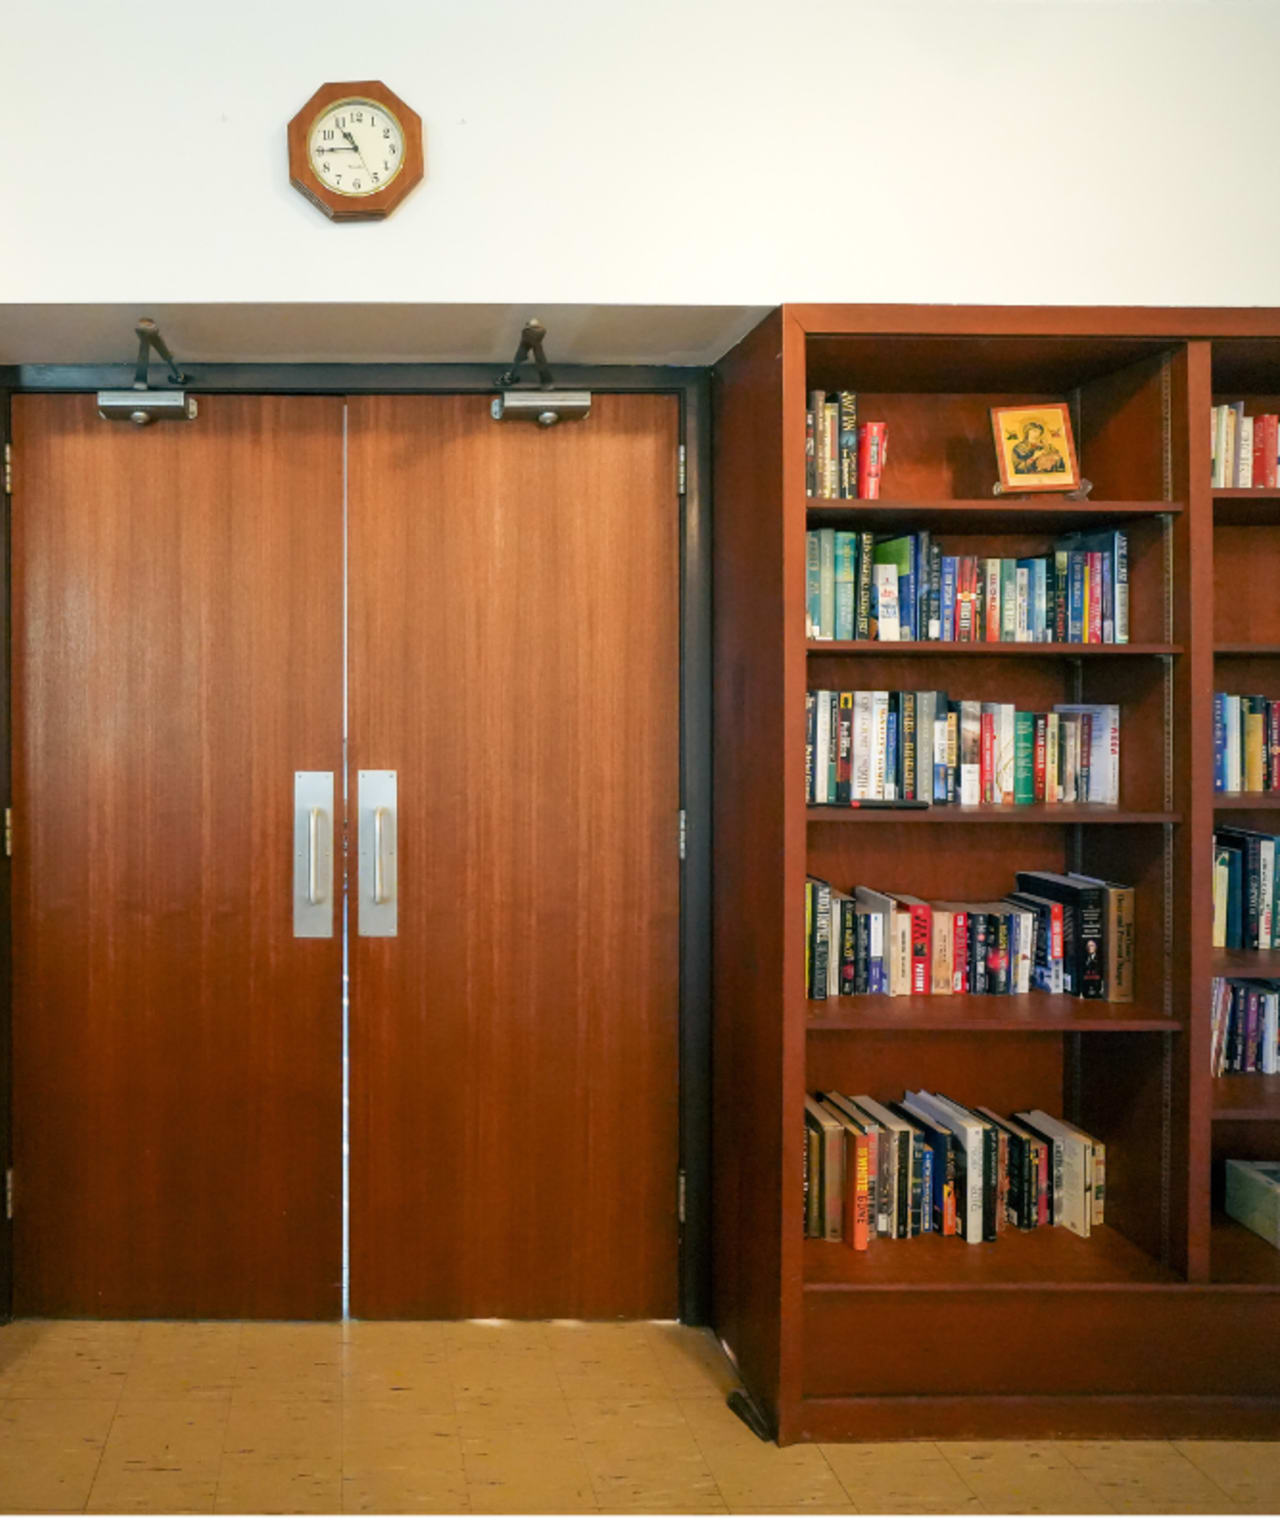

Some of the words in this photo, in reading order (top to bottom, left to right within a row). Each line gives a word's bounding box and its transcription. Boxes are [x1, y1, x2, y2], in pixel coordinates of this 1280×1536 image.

[350, 112, 363, 123] 12
[322, 130, 334, 141] 10
[841, 414, 857, 431] TAN
[989, 573, 997, 586] LEE
[1116, 960, 1124, 986] Danger
[857, 1158, 868, 1191] WHITE
